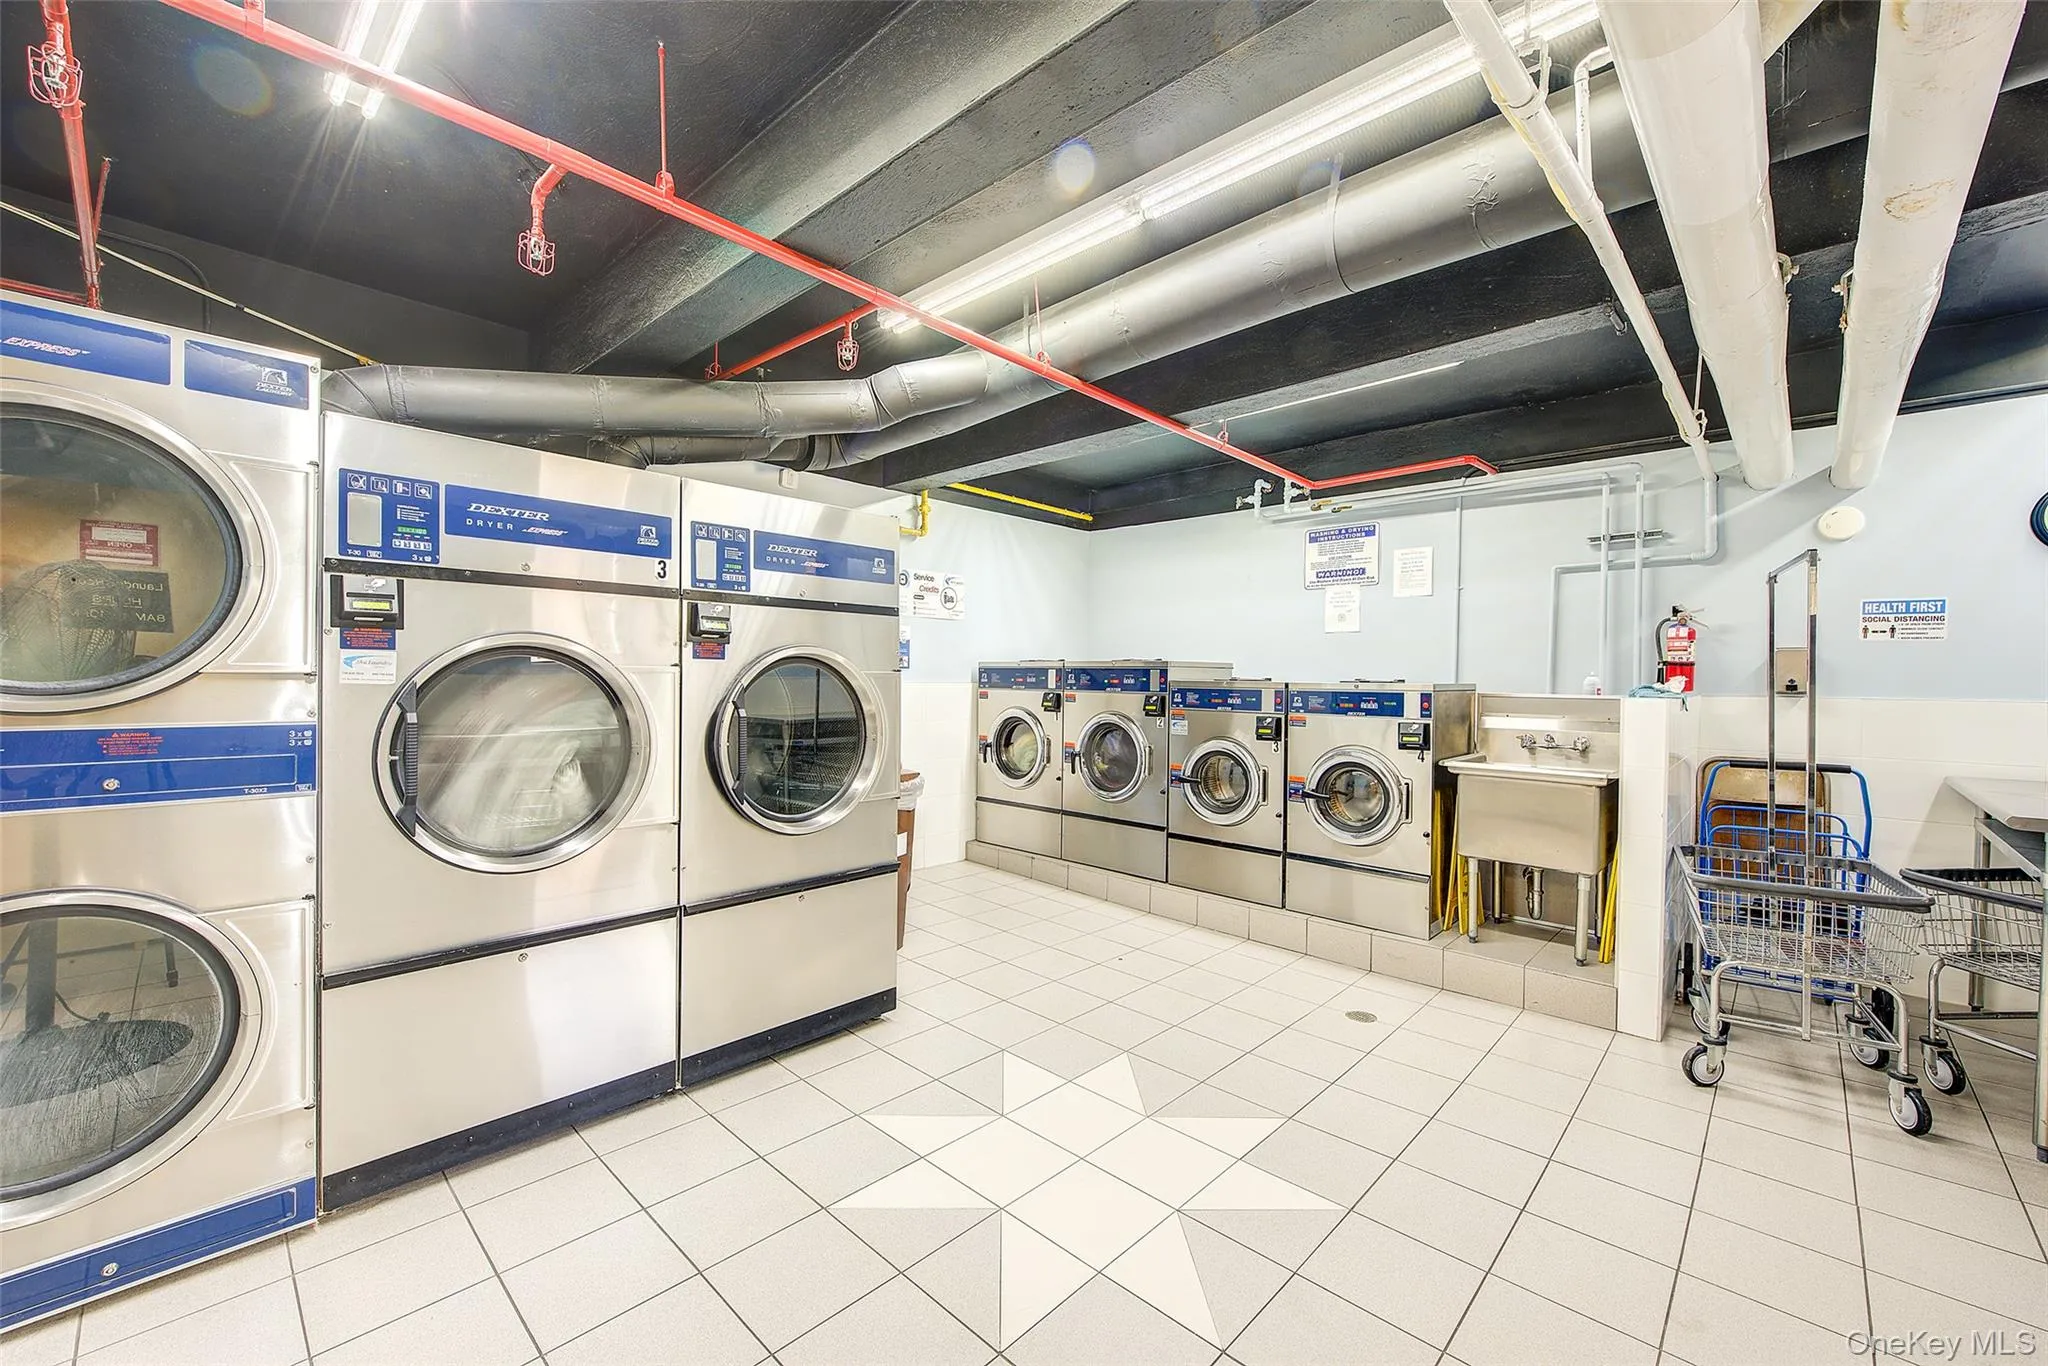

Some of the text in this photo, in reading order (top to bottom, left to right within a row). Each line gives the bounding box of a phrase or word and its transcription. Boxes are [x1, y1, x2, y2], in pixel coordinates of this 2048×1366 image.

[3, 336, 81, 357] EXPRESS
[467, 503, 549, 521] DEXTER
[466, 518, 513, 531] DRYER
[1317, 532, 1366, 541] INSTRUCTIONS
[767, 544, 817, 557] DEXTER
[766, 556, 796, 565] DRYER
[657, 560, 667, 579] 3
[913, 573, 935, 582] Service
[919, 585, 939, 593] Credits
[1864, 601, 1943, 613] HEALTH FIRST
[1894, 615, 1945, 623] DISTANCING
[1157, 718, 1163, 727] 2
[1273, 741, 1279, 752] 3
[1417, 750, 1424, 762] 4
